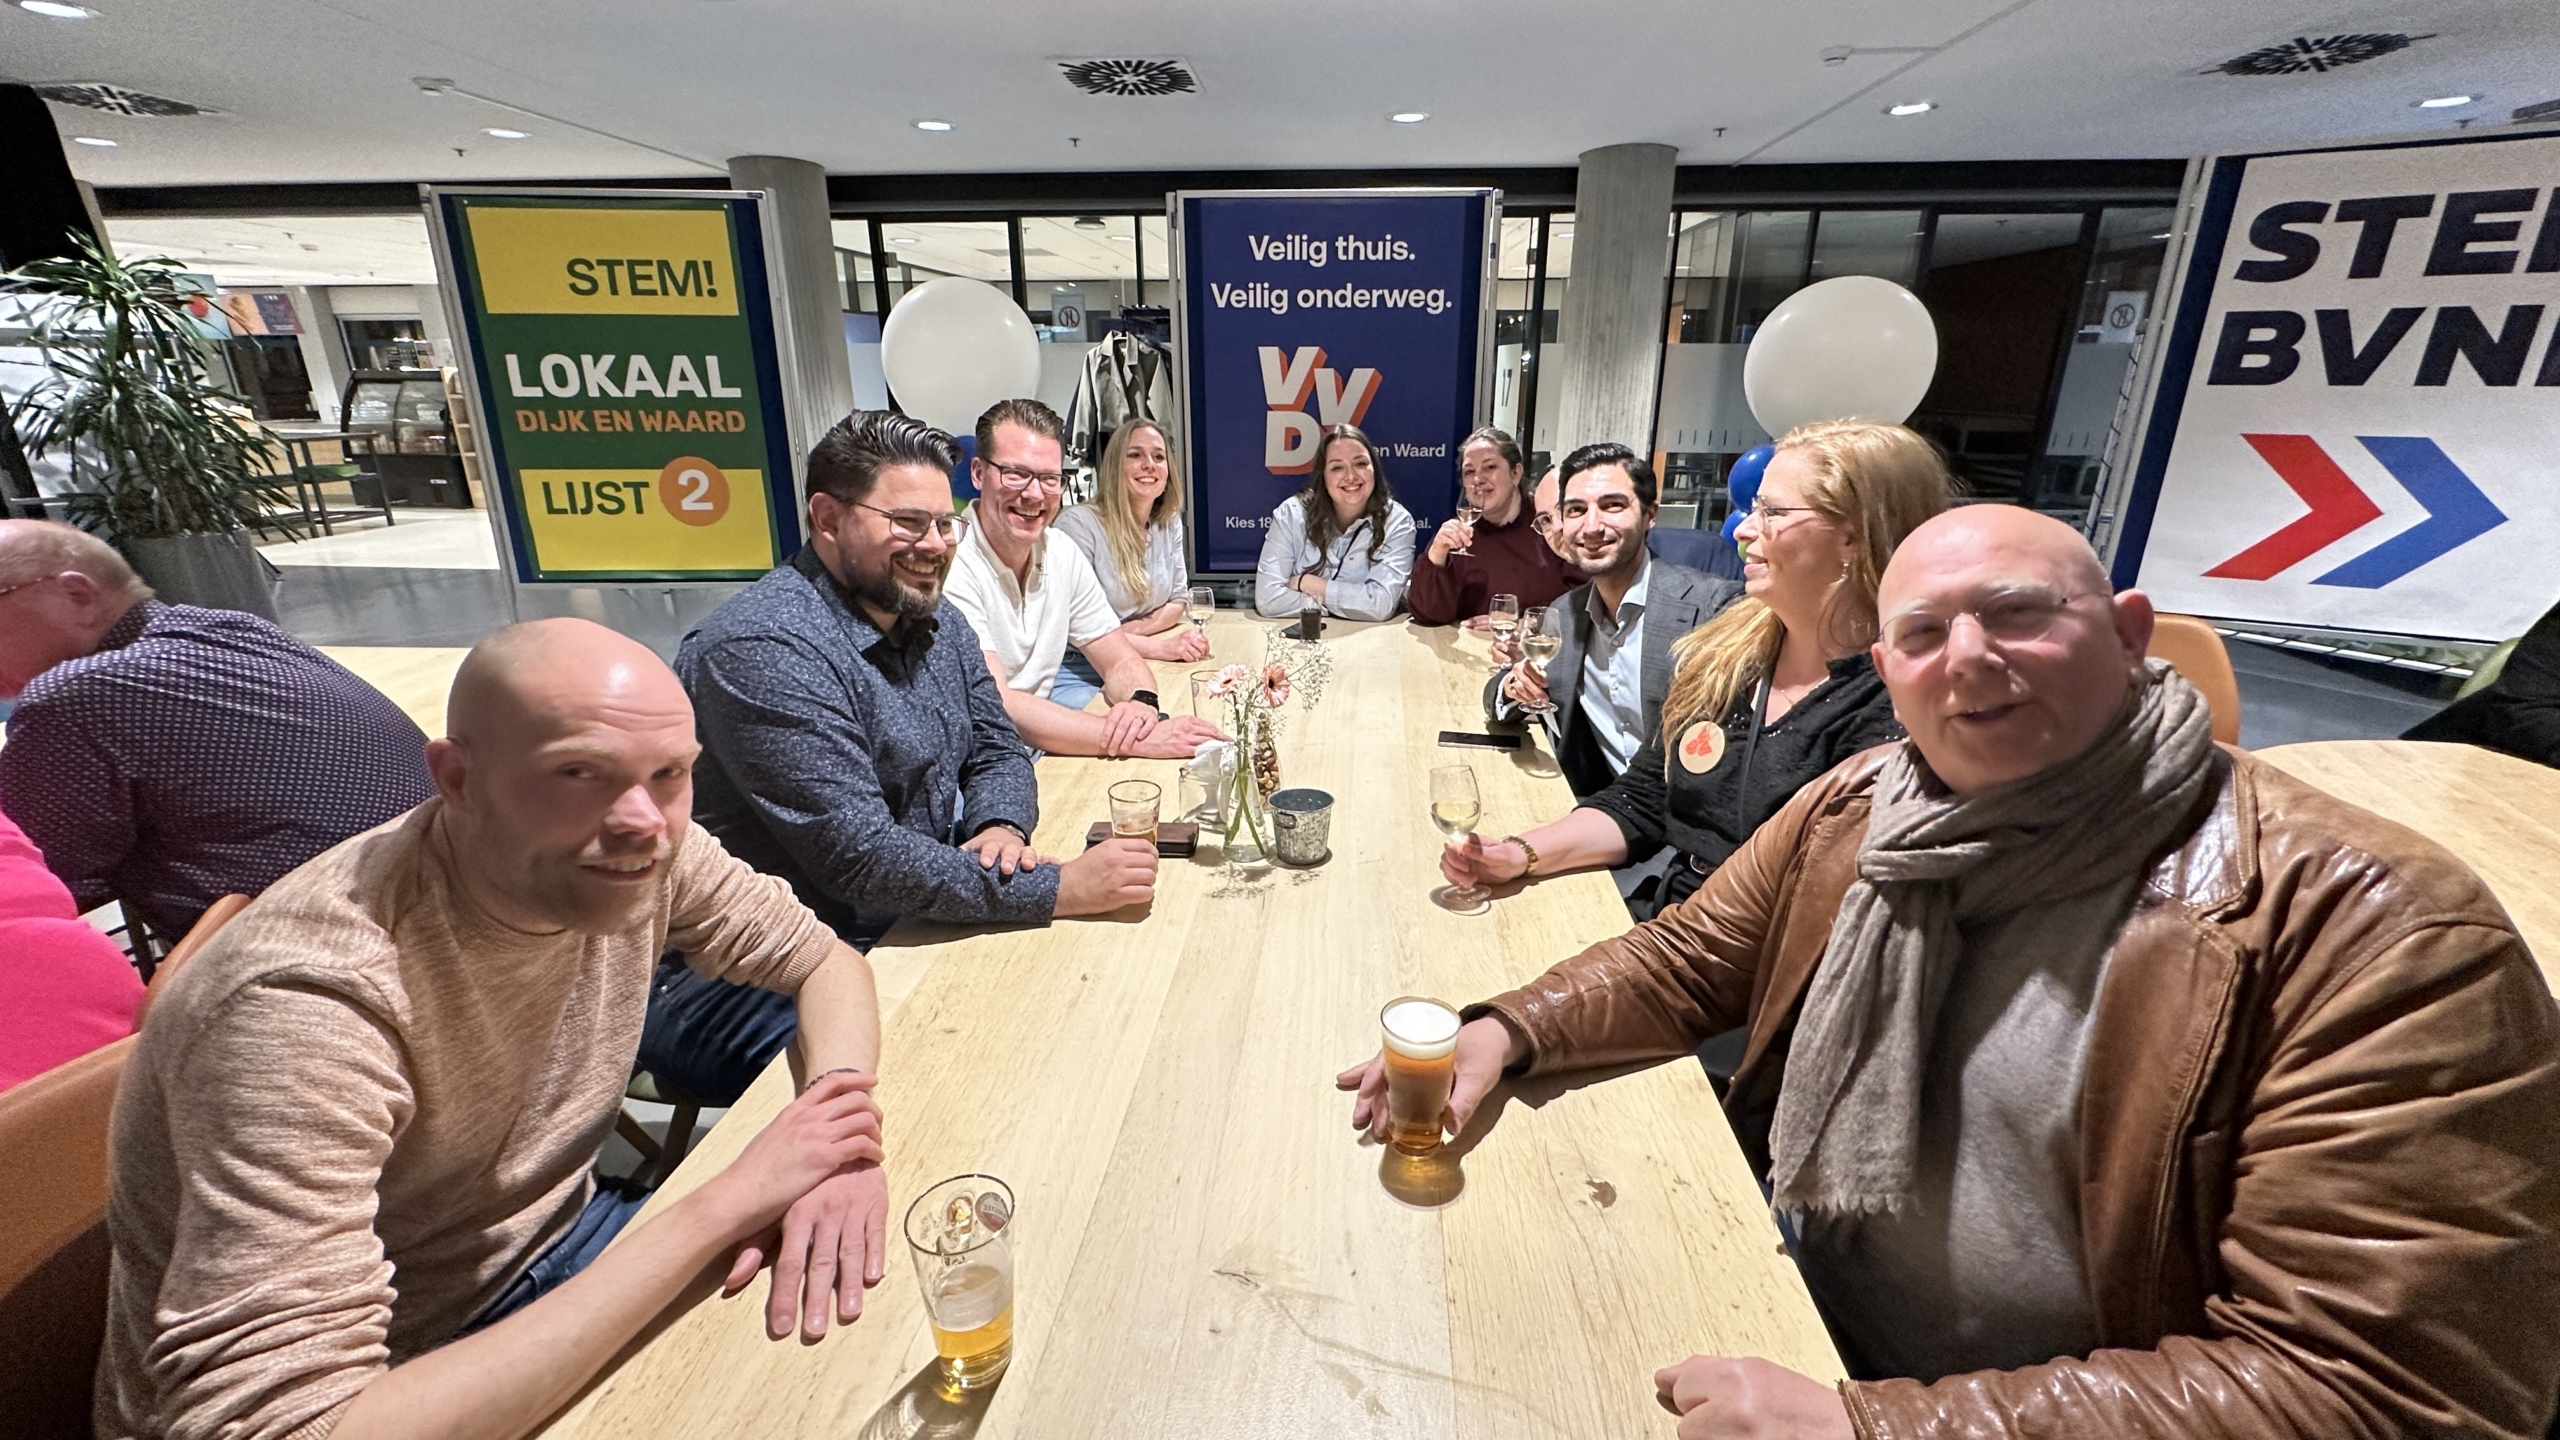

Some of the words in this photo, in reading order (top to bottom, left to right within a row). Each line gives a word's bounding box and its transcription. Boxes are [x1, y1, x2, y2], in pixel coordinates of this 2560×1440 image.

[1248, 234, 1327, 267] Veilig
[1335, 234, 1416, 261] thuis.
[2233, 186, 2560, 282] STE
[566, 258, 718, 298] STEM!
[1210, 282, 1288, 315] Veilig
[1297, 282, 1453, 315] onderweg.
[2207, 304, 2560, 387] BVN
[505, 353, 742, 398] LOKAAL
[515, 409, 590, 433] DIJK
[594, 409, 634, 433] EN
[639, 410, 746, 433] WAARD
[1393, 443, 1446, 458] Waard
[541, 481, 650, 515] LIJST
[677, 469, 714, 511] 2
[1225, 516, 1256, 529] Kies
